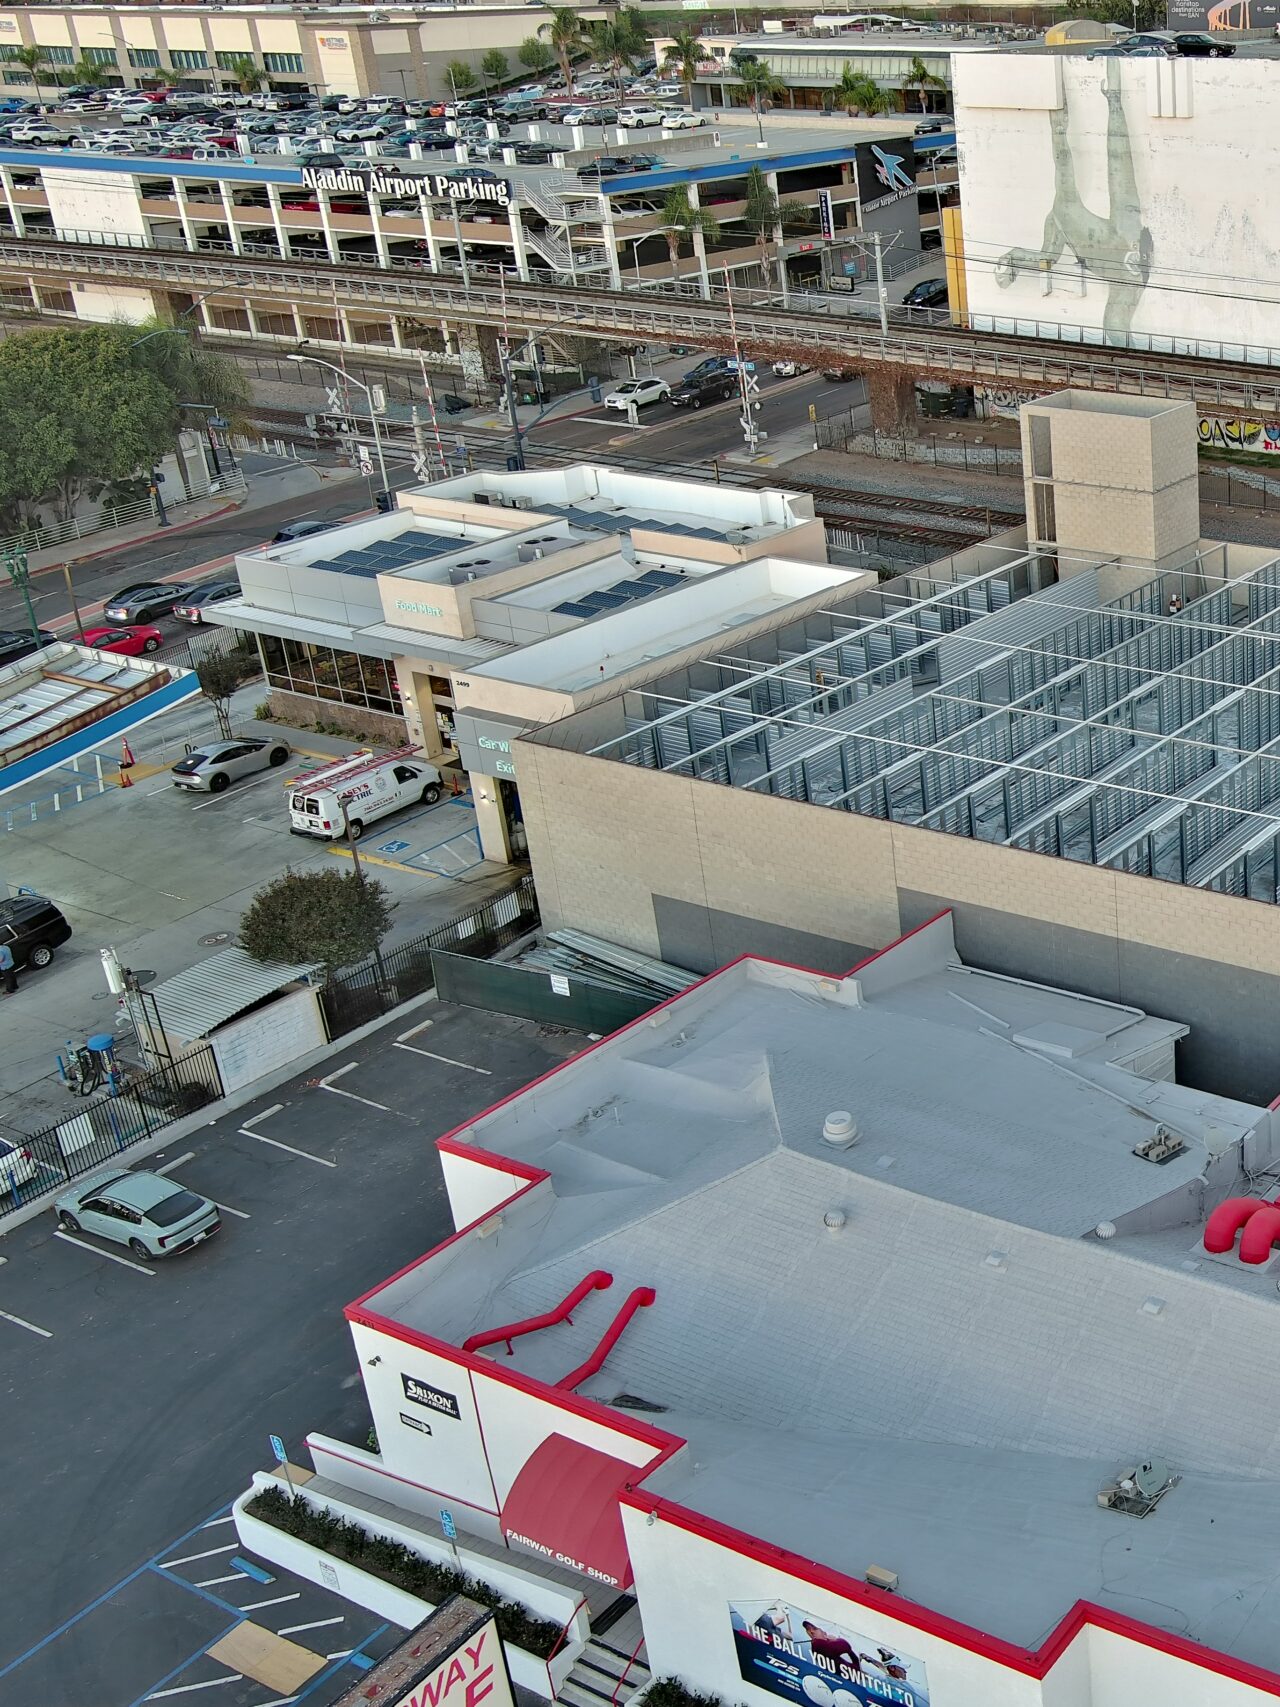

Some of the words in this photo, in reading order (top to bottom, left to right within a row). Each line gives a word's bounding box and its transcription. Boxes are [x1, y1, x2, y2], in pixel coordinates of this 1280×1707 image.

[301, 168, 365, 191] Aladdin
[370, 171, 432, 199] Airport
[435, 175, 508, 206] Parking
[821, 196, 829, 233] PARKING
[395, 600, 417, 612] Food
[419, 603, 442, 617] Mart
[478, 737, 497, 750] Car
[407, 1380, 452, 1408] SRIXON
[506, 1528, 554, 1557] FAIRWAY
[555, 1552, 585, 1571] GOLF
[587, 1566, 618, 1586] SHOP
[402, 1631, 487, 1707] WAY
[745, 1621, 770, 1645] THE
[772, 1633, 808, 1661] BALL
[809, 1649, 836, 1674] YOU
[840, 1663, 893, 1700] SWITCH
[895, 1687, 914, 1707] TO
